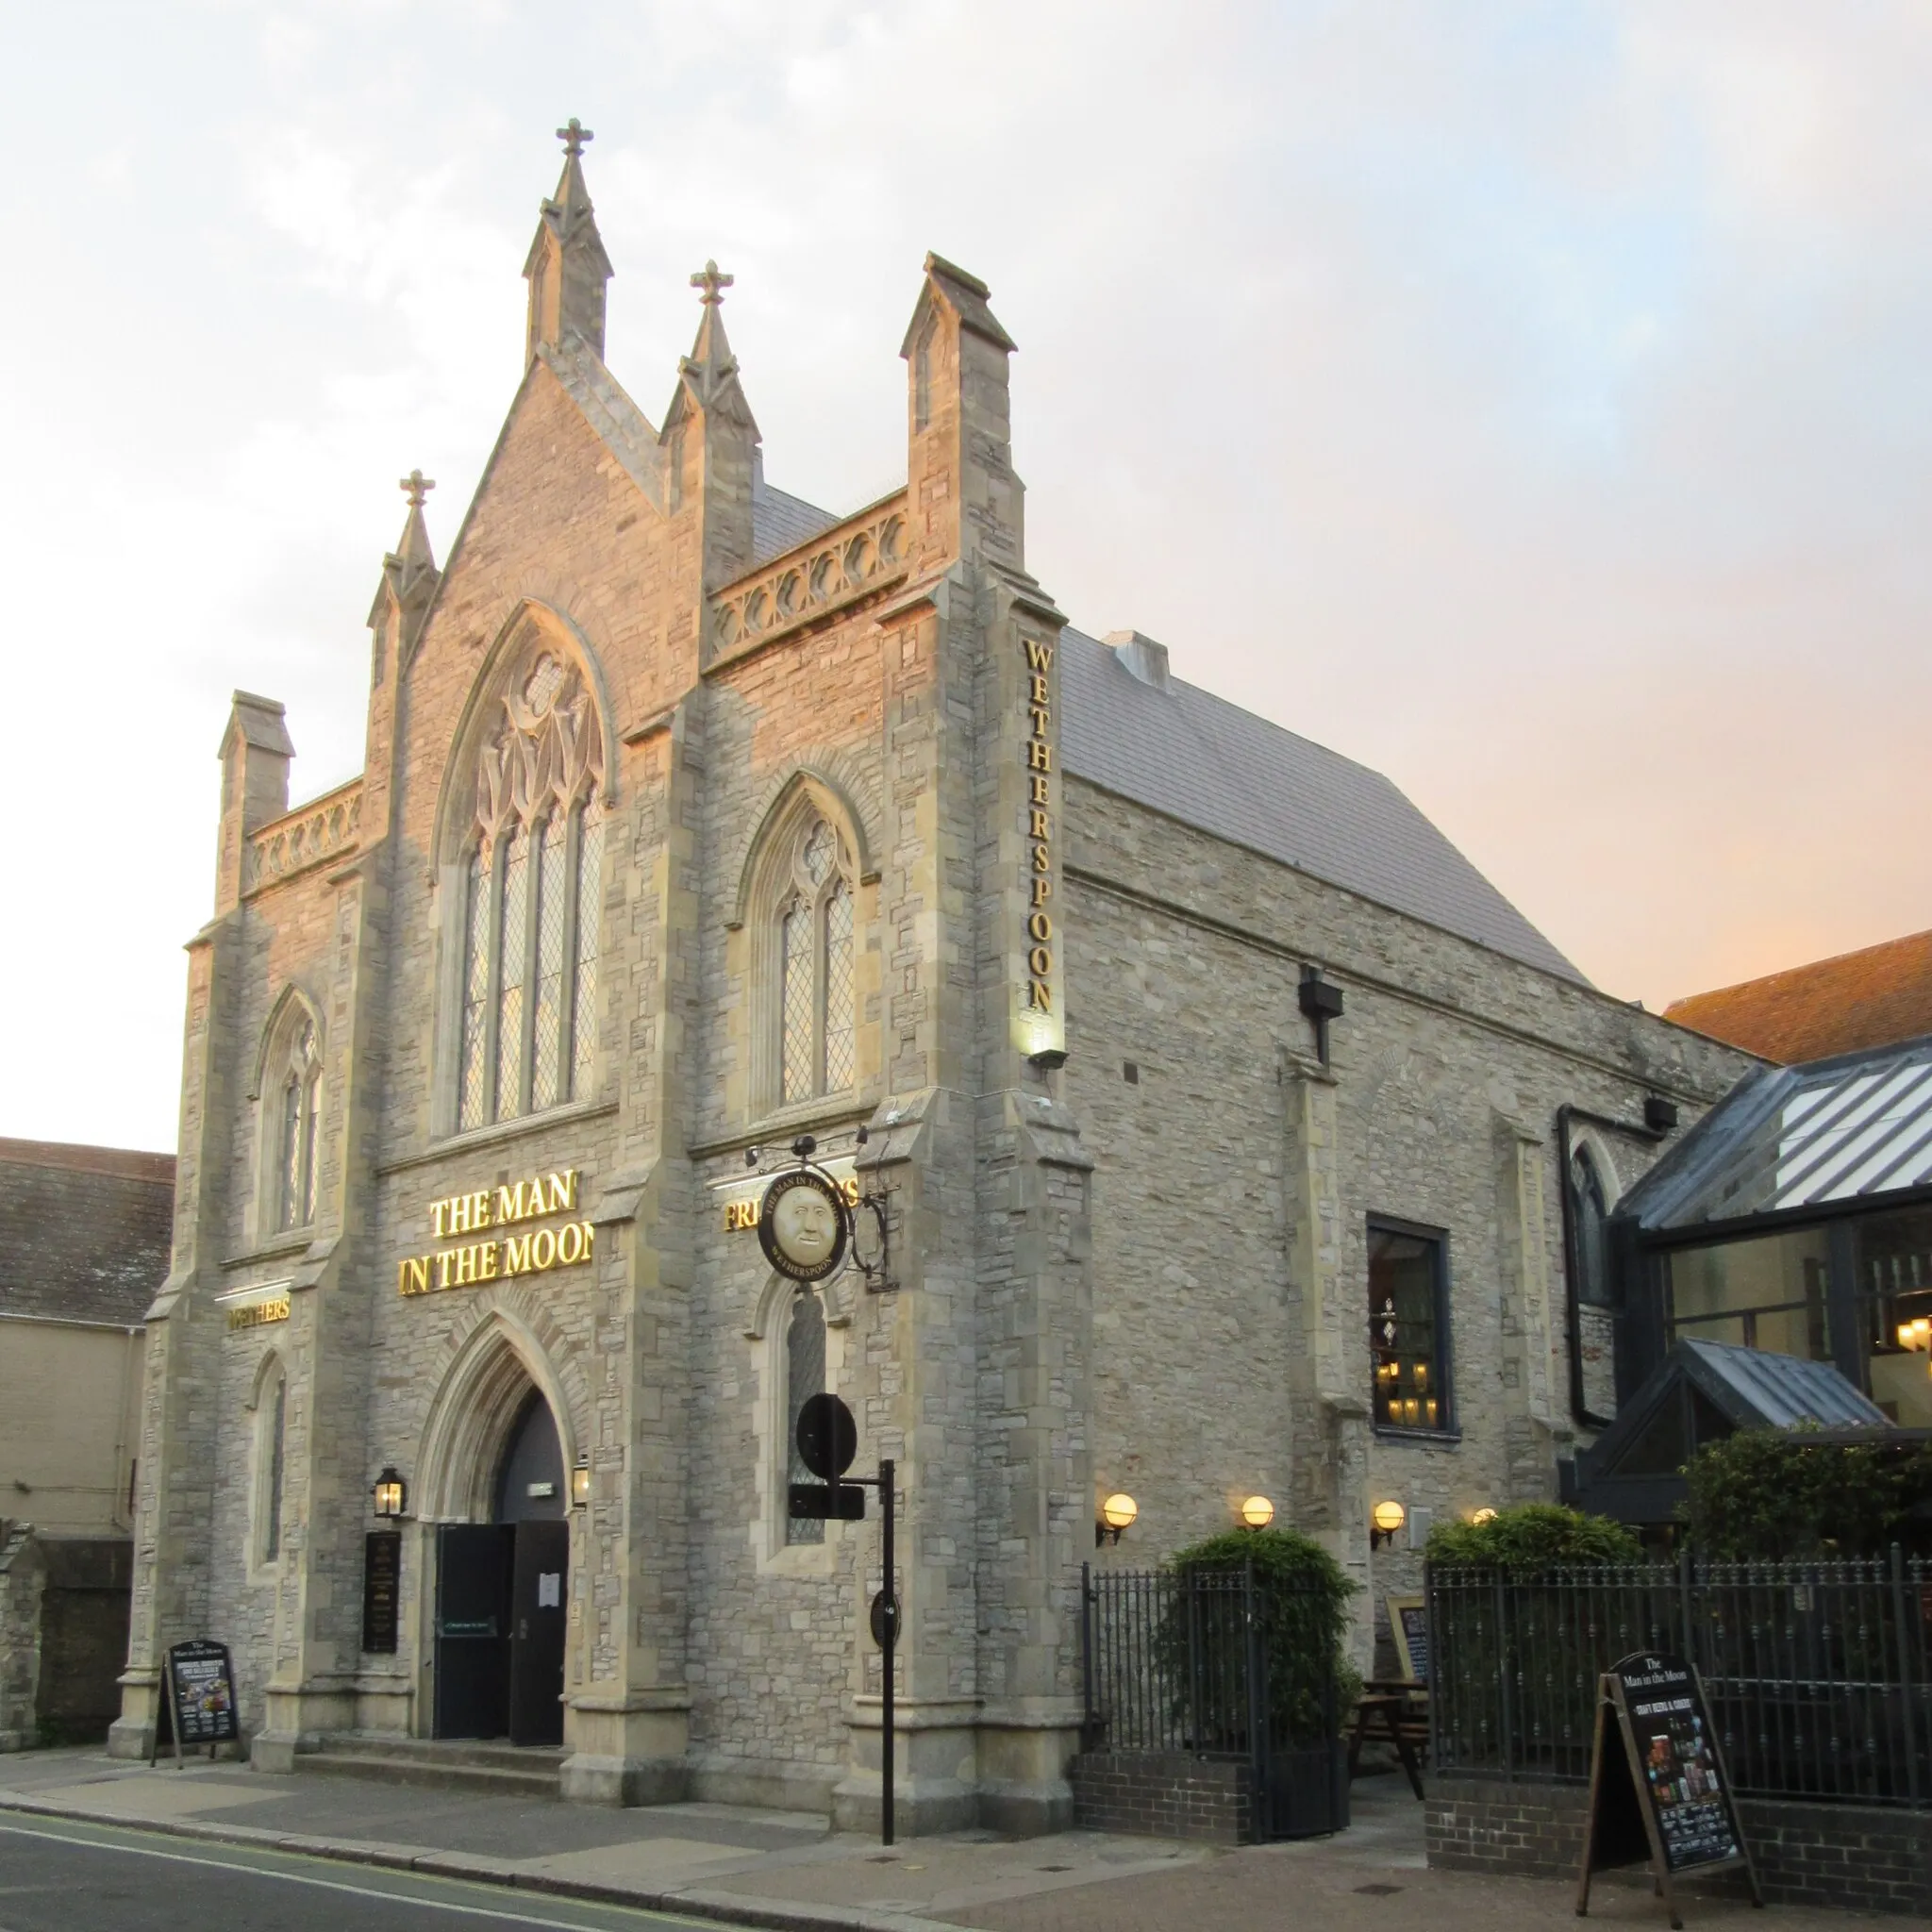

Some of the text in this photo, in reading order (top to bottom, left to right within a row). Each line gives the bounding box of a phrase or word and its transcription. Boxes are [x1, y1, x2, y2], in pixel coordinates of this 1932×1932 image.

[1024, 640, 1054, 1012] WETHERSPOON
[774, 1177, 794, 1193] MAN
[795, 1175, 808, 1185] IN
[430, 1169, 577, 1238] THE MAN
[398, 1256, 431, 1296] IN
[437, 1241, 497, 1288] THE
[772, 1245, 832, 1276] WETHERSPOON
[1624, 1670, 1687, 1688] Man in the Moon
[1645, 1657, 1661, 1670] The
